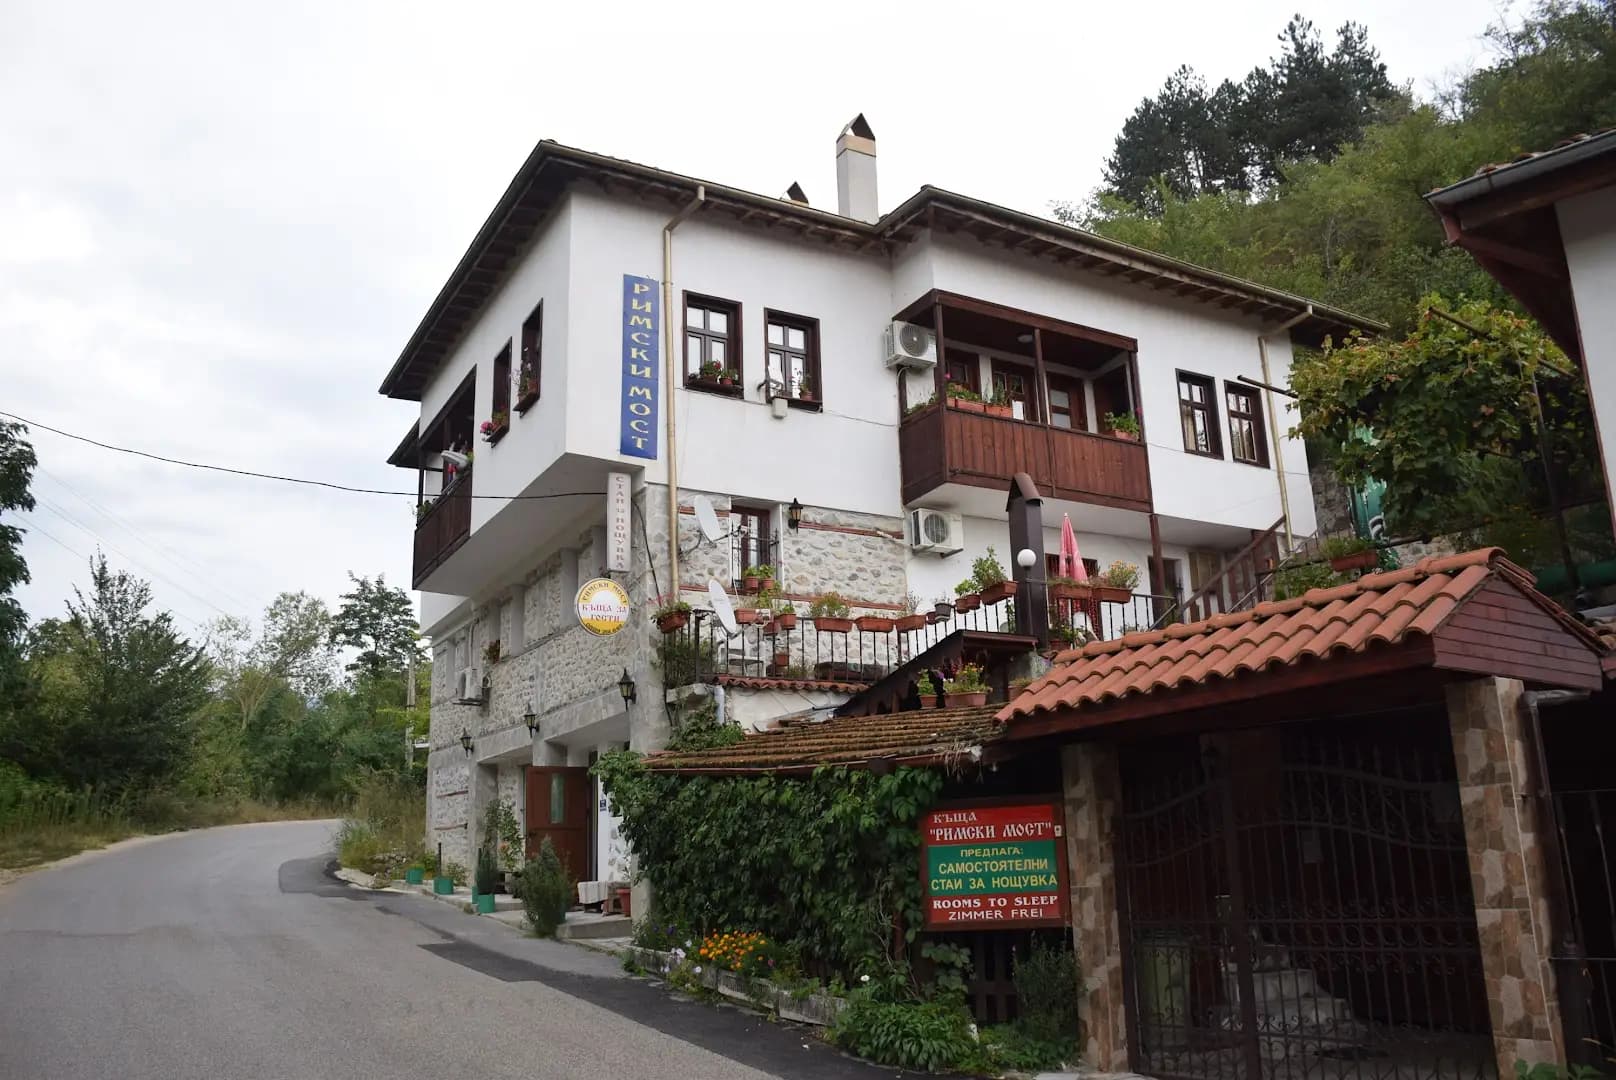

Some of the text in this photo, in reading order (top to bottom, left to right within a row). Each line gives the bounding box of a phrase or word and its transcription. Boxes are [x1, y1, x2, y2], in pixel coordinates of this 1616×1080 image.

[629, 283, 653, 449] РИМСКИ МОСТ
[582, 582, 609, 601] РИМСКИ
[933, 812, 977, 824] КЪЩА
[930, 822, 1052, 841] "РИМСКИ МОСТ"
[960, 847, 1024, 858] ПРЕДЛАГА:
[938, 858, 1048, 875] САМОСТОЯТЕЛНИ
[931, 874, 1058, 891] СТАИ ЗА НОЩУВКА
[933, 895, 1058, 909] ROOMS TO SLEEP
[949, 908, 1043, 921] ZIMMER FREI
